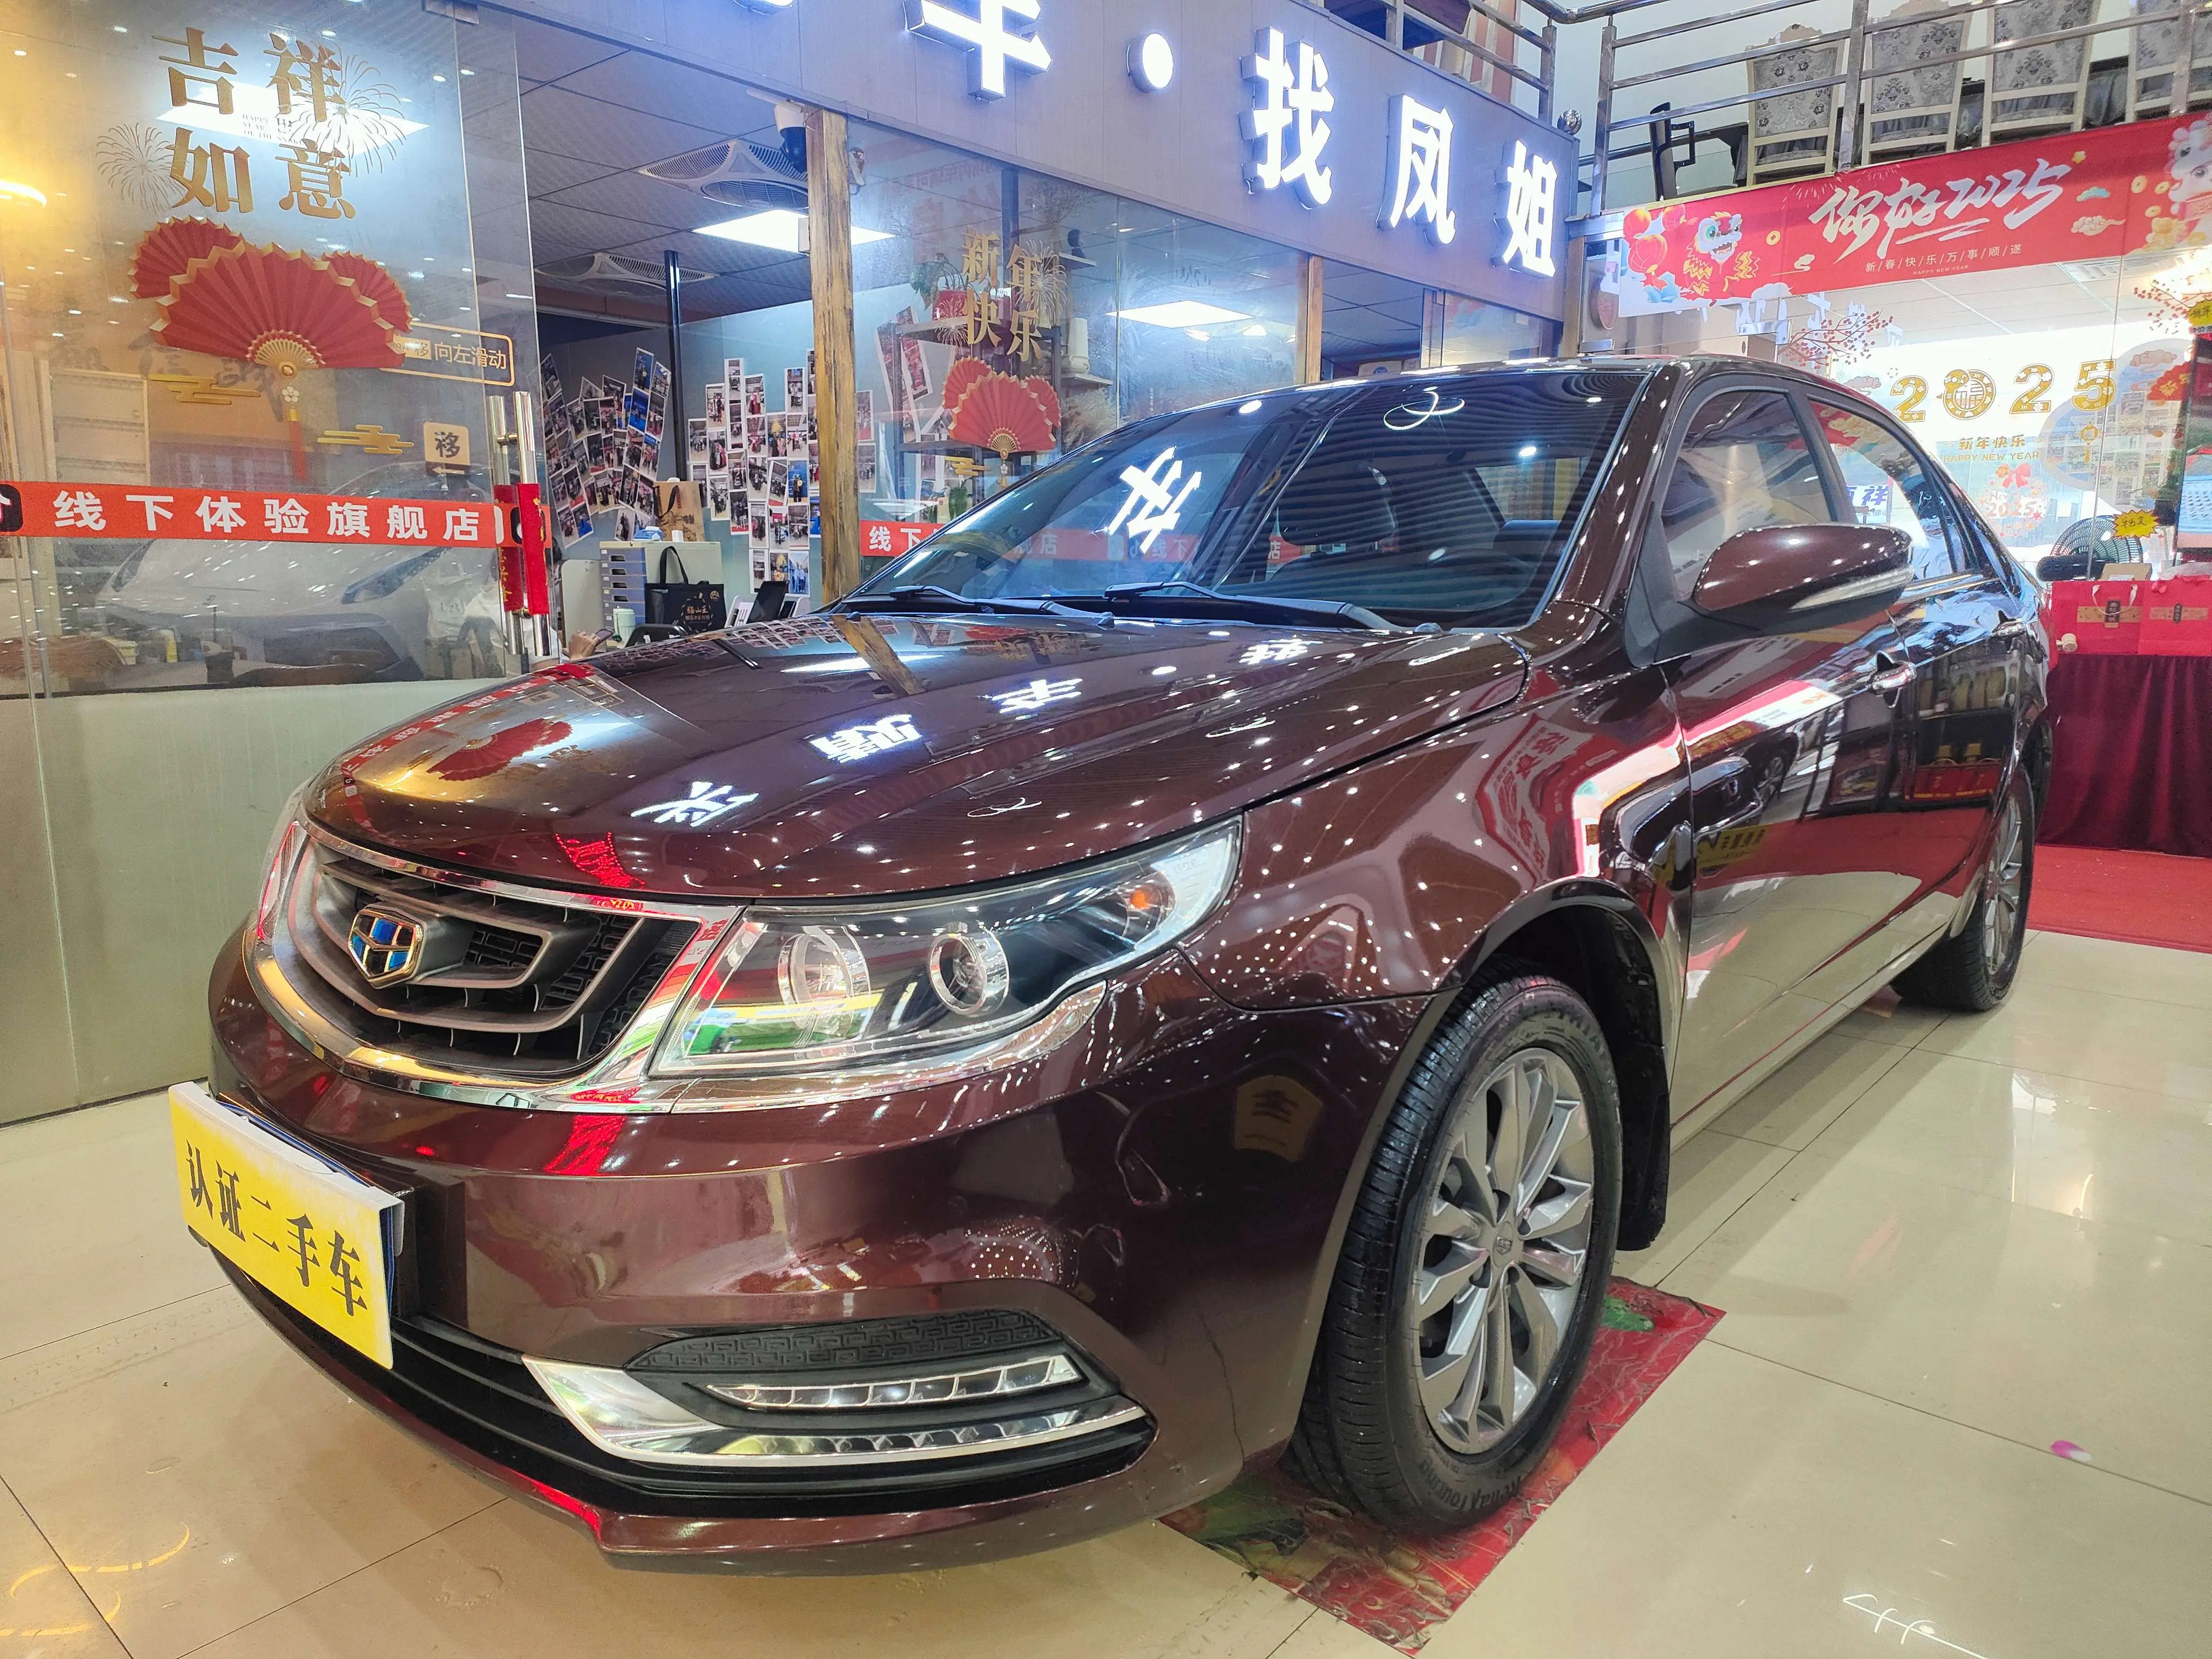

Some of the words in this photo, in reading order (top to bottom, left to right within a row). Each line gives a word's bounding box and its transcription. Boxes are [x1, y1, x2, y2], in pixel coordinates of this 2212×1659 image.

[152, 26, 346, 122] 吉祥
[165, 126, 356, 219] 如意
[1253, 26, 1558, 278] 找凤姐
[961, 226, 1042, 302] 新年
[434, 342, 507, 369] 向左滑动
[961, 287, 1043, 362] 快乐
[434, 431, 461, 458] 移
[1944, 454, 1978, 462] HAPPY
[2009, 451, 2039, 460] YEAR
[1958, 434, 2025, 450] 新年快乐
[53, 489, 480, 542] 线下体验旗舰店
[186, 1139, 368, 1317] 认证二手车
